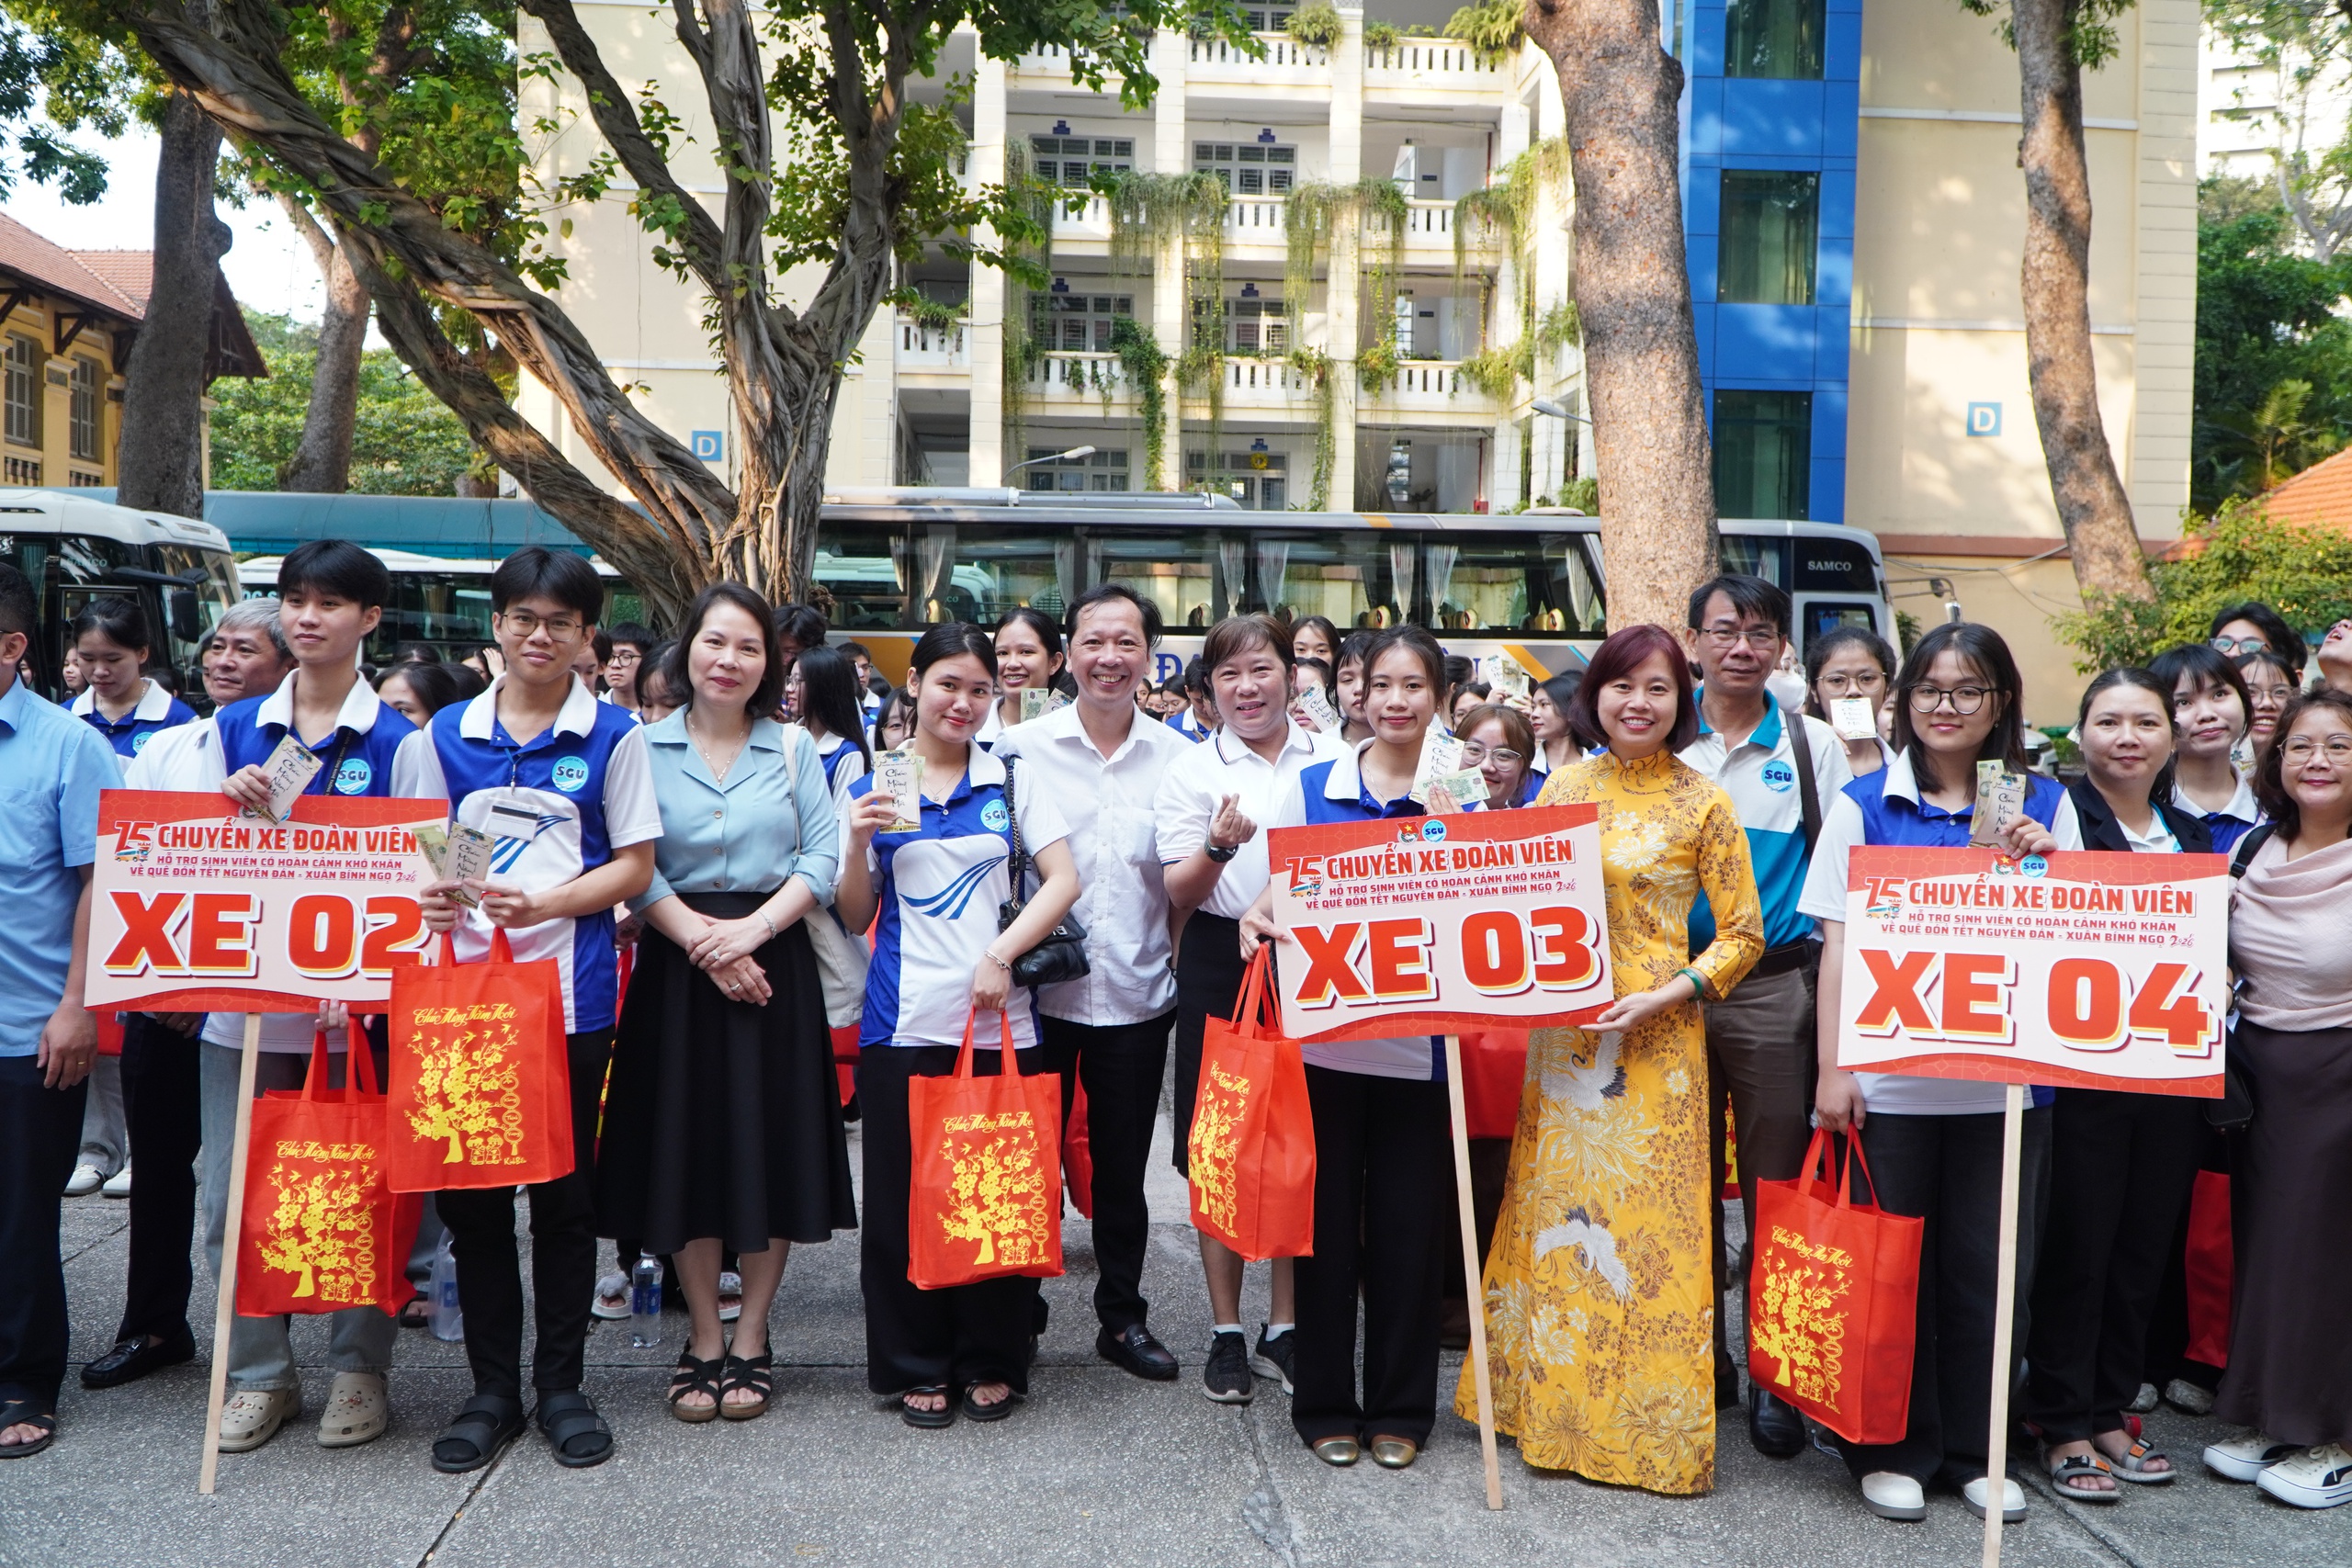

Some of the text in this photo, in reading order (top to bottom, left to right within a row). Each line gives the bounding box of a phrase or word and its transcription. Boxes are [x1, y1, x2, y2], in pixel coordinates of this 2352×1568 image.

[1973, 407, 1996, 432] D
[697, 436, 716, 457] D
[1808, 561, 1852, 571] SAMCO
[338, 770, 367, 781] SGU
[556, 766, 584, 779] SGU
[1765, 770, 1792, 782] SGU
[985, 810, 1005, 821] SGU
[158, 817, 418, 854] CHUYẾN XE ĐOÀN VIÊN
[157, 852, 401, 869] HỖ TRỢ SINH VIÊN CÓ HOÀN CẢNH KHÓ KHĂN
[1327, 835, 1573, 880] CHUYẾN XE ĐOÀN VIÊN
[2023, 862, 2045, 870] SGU
[130, 863, 143, 876] VỀ
[148, 865, 169, 877] QUÊ
[173, 865, 196, 876] ĐÓN
[199, 865, 218, 876] TẾT
[223, 867, 268, 877] NGUYÊN
[272, 868, 295, 878] ĐÁN
[305, 869, 336, 879] XUÂN
[340, 870, 366, 880] BÍNH
[369, 872, 391, 884] NGỌ
[396, 870, 417, 883] 2026
[1329, 869, 1560, 897] HỖ TRỢ SINH VIÊN CÓ HOÀN CẢNH KHÓ KHĂN
[1306, 897, 1319, 909] VỀ
[1322, 897, 1342, 909] QUÊ
[1345, 895, 1367, 907] ĐÓN
[1370, 893, 1388, 905] TẾT
[1392, 891, 1434, 902] NGUYÊN
[1437, 888, 1459, 900] ĐÁN
[1470, 885, 1498, 897] XUÂN
[1502, 883, 1527, 894] BÍNH
[1531, 883, 1552, 895] NGỌ
[1556, 878, 1577, 892] 2026
[1909, 873, 2194, 915] CHUYẾN XE ĐOÀN VIÊN
[1908, 909, 2176, 931] HỖ TRỢ SINH VIÊN CÓ HOÀN CẢNH KHÓ KHĂN
[101, 890, 430, 979] XE 02
[1882, 920, 1894, 932] VỀ
[1899, 922, 1921, 933] QUÊ
[1925, 923, 1949, 935] ĐÓN
[1952, 923, 1973, 936] TẾT
[1977, 926, 2025, 938] NGUYÊN
[2030, 928, 2054, 939] ĐÁN
[2066, 930, 2100, 941] XUÂN
[2104, 931, 2134, 942] BÍNH
[2139, 934, 2165, 948] NGỌ
[2169, 933, 2195, 947] 2026
[1288, 905, 1603, 1009] XE 03
[1854, 947, 2221, 1058] XE 04
[413, 1008, 441, 1026] Chúc
[943, 1116, 969, 1134] Chúc
[277, 1141, 303, 1158] Chúc
